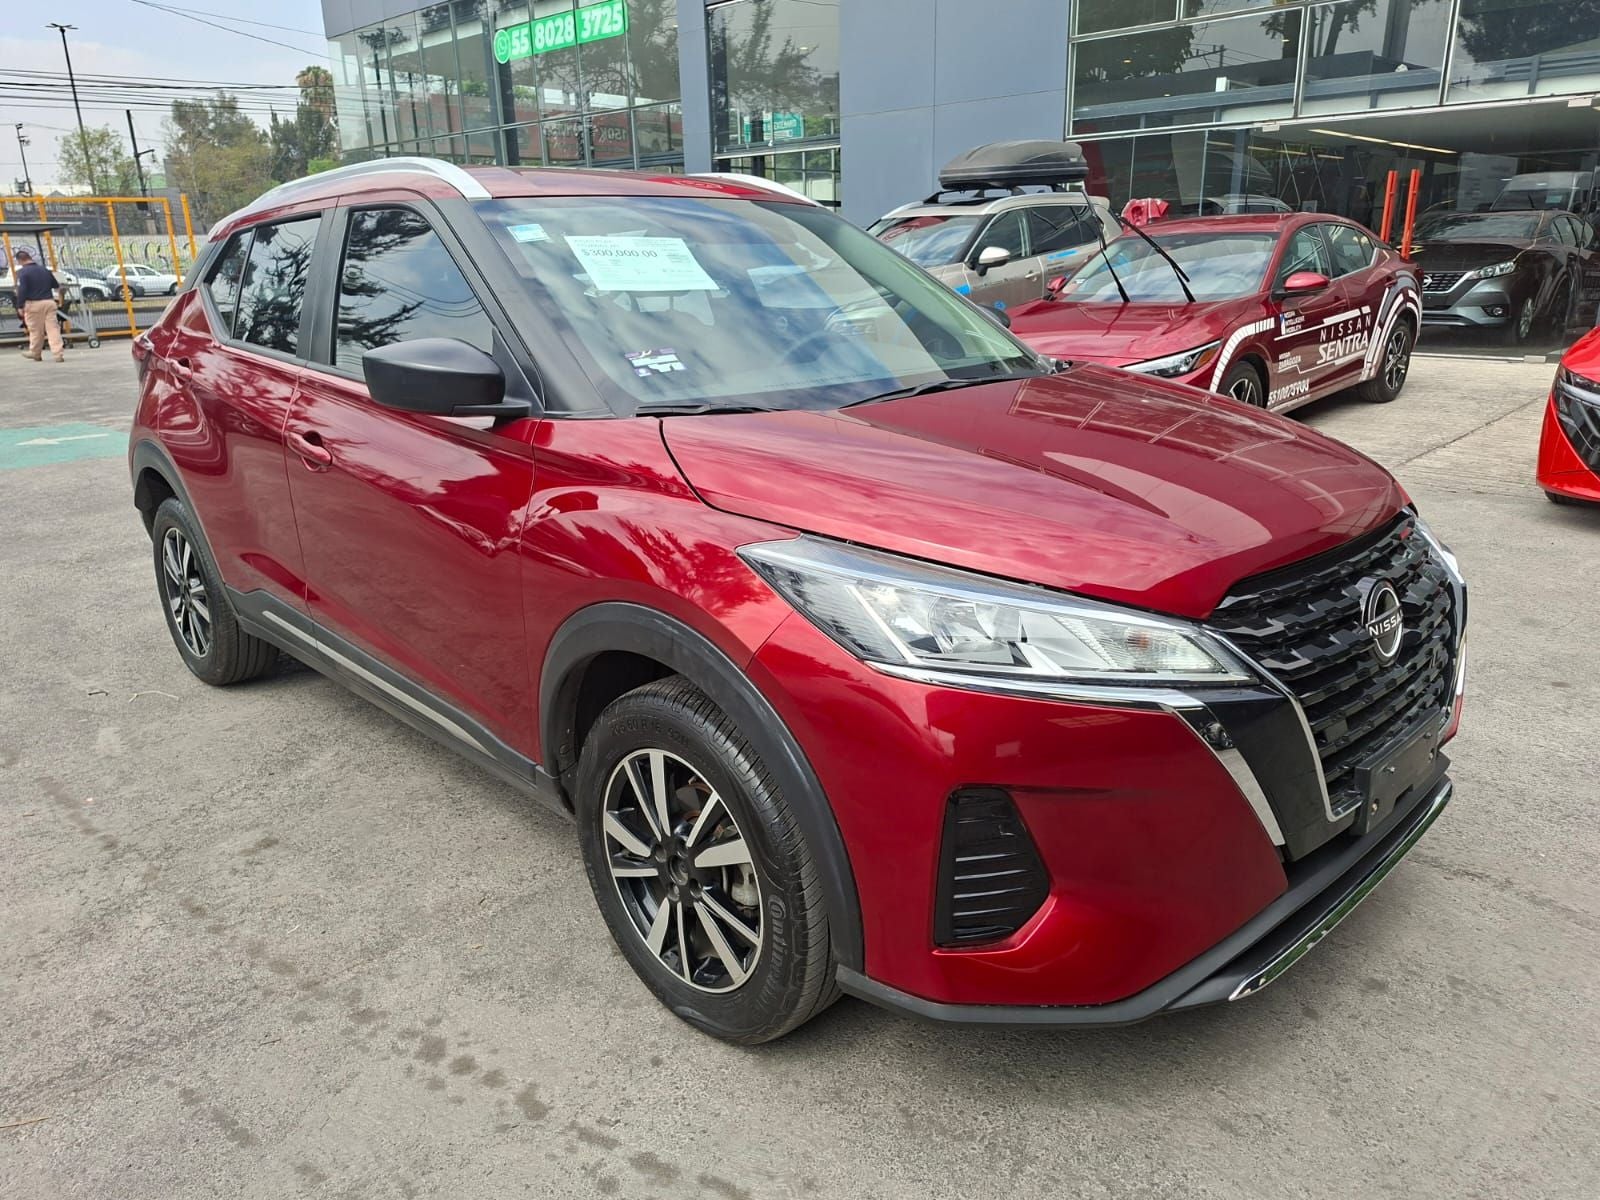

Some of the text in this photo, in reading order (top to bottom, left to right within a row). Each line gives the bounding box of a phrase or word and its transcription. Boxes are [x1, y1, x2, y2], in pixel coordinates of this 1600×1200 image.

[511, 4, 623, 56] 55 8028 3725
[1319, 314, 1371, 342] NISSAN
[1317, 330, 1369, 364] SENTRA
